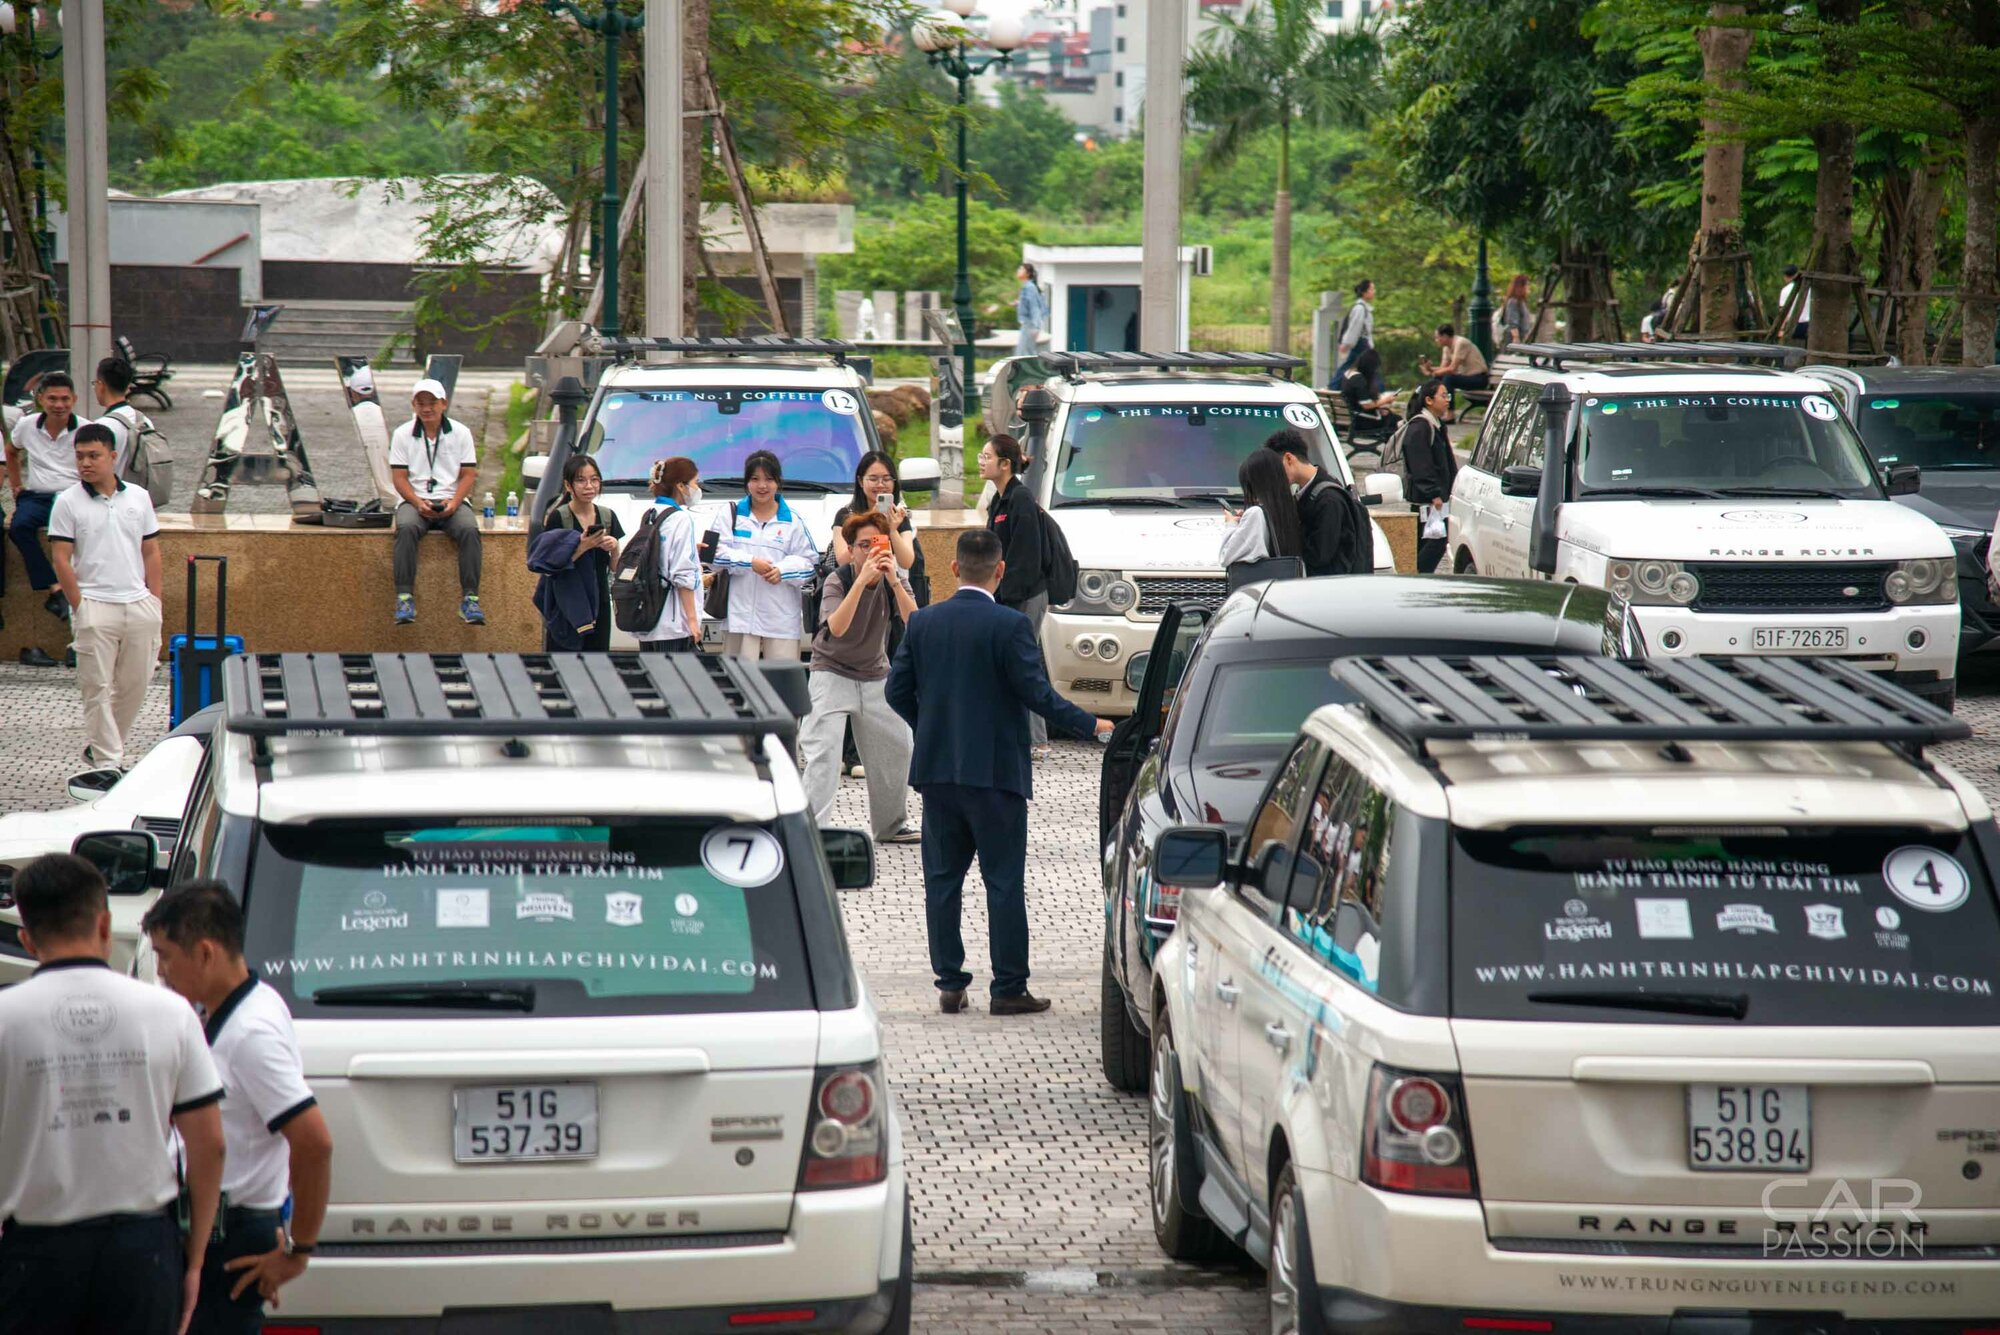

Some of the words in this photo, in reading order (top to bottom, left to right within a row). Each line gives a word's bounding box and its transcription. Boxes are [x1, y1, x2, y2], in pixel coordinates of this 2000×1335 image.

[651, 393, 684, 402] THE
[694, 391, 733, 401] No.1
[742, 392, 813, 401] COFFEE!
[830, 395, 854, 410] 12
[1633, 398, 1668, 409] THE
[1678, 396, 1717, 406] No.1
[1726, 397, 1797, 409] COFFEE!
[1118, 408, 1151, 418] THE
[1161, 406, 1200, 415] No.1
[1208, 407, 1278, 419] COFFEE!
[1290, 408, 1314, 424] 18
[1808, 400, 1830, 415] 17
[1709, 548, 1785, 556] RANGE
[1800, 548, 1875, 556] ROVER
[725, 836, 755, 872] 7
[624, 863, 664, 881] TIM
[1912, 859, 1944, 896] 4
[1818, 877, 1861, 894] TIM
[341, 912, 409, 932] Legend
[1544, 920, 1613, 943] Legend
[496, 1089, 558, 1120] 51G
[1717, 1088, 1781, 1125] 51G
[471, 1123, 583, 1155] 537.39
[1692, 1128, 1806, 1165] 538.94
[352, 1215, 513, 1234] RANGE
[546, 1211, 700, 1231] ROVER
[1579, 1214, 1738, 1236] RANGE
[1776, 1219, 1930, 1237] ROVER
[1558, 1273, 1957, 1296] WWW.TRUNGNGUYENLEGEND.COM
